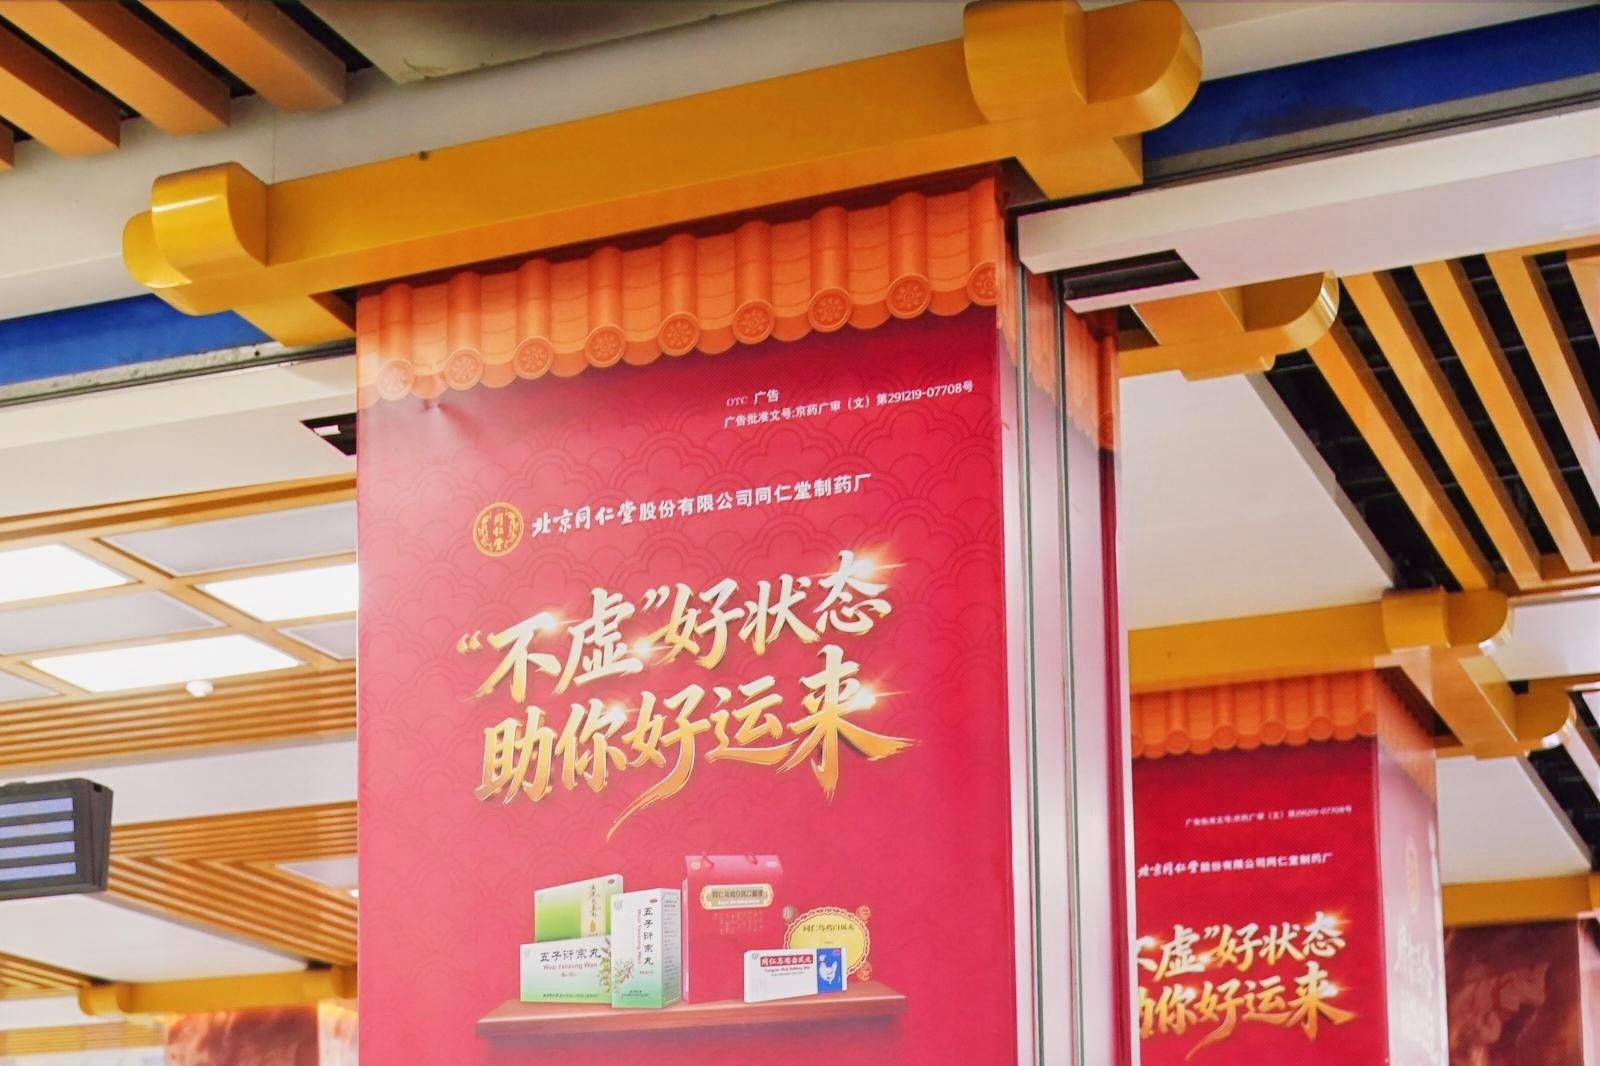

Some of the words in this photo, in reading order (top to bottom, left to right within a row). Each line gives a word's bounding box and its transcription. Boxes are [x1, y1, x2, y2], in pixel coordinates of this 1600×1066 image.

[726, 397, 748, 406] OTC
[754, 389, 779, 405] 广告
[532, 473, 871, 537] 北京同仁堂股份有限公司同仁堂制药厂
[474, 645, 921, 842] 助你好运来
